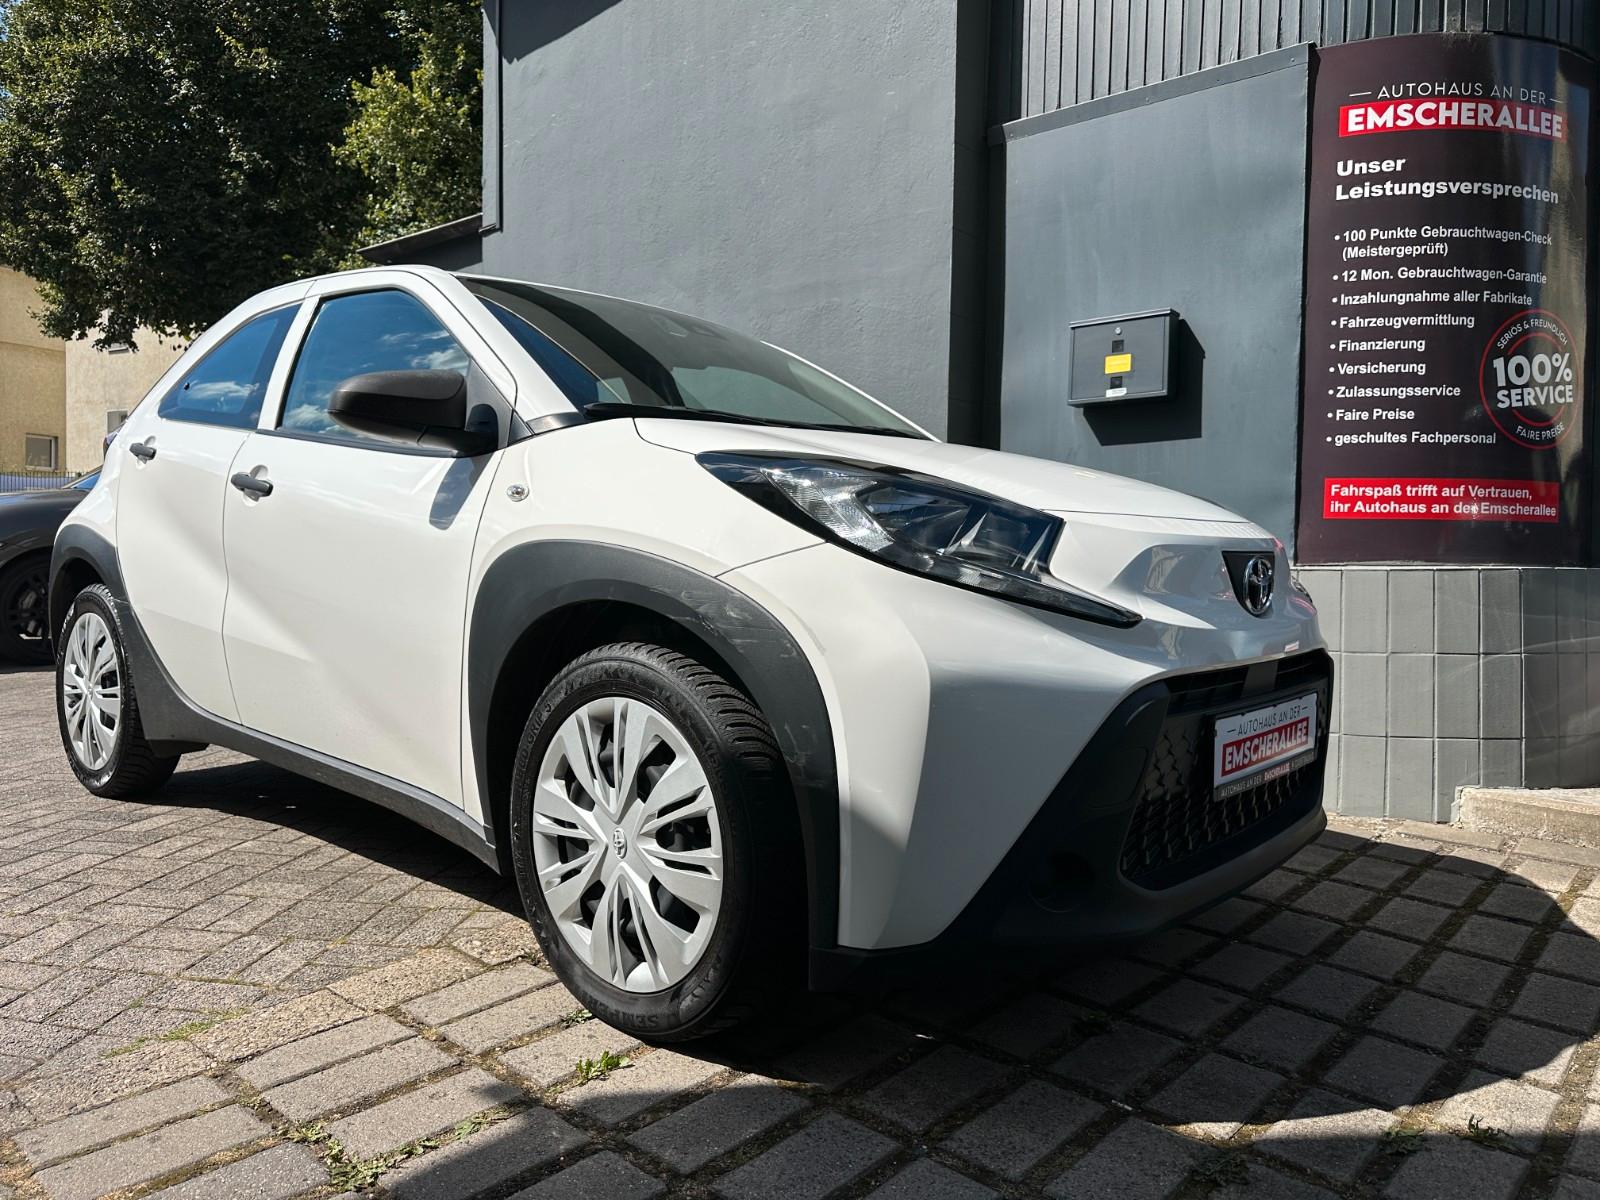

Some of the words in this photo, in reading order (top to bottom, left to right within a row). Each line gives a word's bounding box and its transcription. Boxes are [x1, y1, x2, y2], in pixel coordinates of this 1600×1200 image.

[1377, 82, 1483, 99] AUTOHAUS
[1490, 84, 1513, 99] AN
[1520, 88, 1546, 105] DER
[1347, 101, 1562, 138] EMSCHERALLEE
[1336, 158, 1406, 177] Unser
[1335, 179, 1559, 204] Leistungsversprechen
[1343, 230, 1367, 242] 100
[1370, 227, 1417, 241] Punkte
[1420, 225, 1553, 246] Gebrauchtwagen-Check
[1342, 242, 1449, 262] (Meistergeprüft)
[1341, 270, 1357, 282] 12
[1360, 268, 1394, 282] Mon.
[1397, 266, 1547, 285] Gebrauchtwagen-Garantie
[1340, 290, 1450, 306] Inzahlungnahme
[1453, 290, 1480, 303] aller
[1483, 290, 1533, 306] Fabrikate
[1339, 313, 1475, 329] Fahrzeugvermittlung
[1530, 318, 1568, 346] FREUNDLICH
[1338, 338, 1426, 352] Finanzierung
[1337, 361, 1426, 375] Versicherung
[1493, 352, 1572, 387] 100%
[1336, 384, 1461, 399] Zulassungsservice
[1496, 384, 1574, 409] SERVICE
[1335, 408, 1369, 421] Faire
[1372, 408, 1415, 420] Preise
[1334, 431, 1408, 447] geschultes
[1411, 431, 1497, 446] Fachpersonal
[1516, 425, 1540, 440] FAIRE
[1541, 422, 1565, 440] PREISE
[1330, 484, 1402, 499] Fahrspaß
[1405, 484, 1438, 497] trifft
[1441, 484, 1465, 497] auf
[1468, 485, 1533, 501] Vertrauen,
[1330, 501, 1351, 513] ihr
[1353, 501, 1427, 514] Autohaus
[1431, 503, 1449, 514] an
[1480, 502, 1557, 517] Emscherallee
[1237, 713, 1277, 737] AUTOHAUS
[1279, 711, 1288, 723] AN
[1289, 705, 1301, 720] DER
[1224, 720, 1308, 771] EMSCHERALLEE
